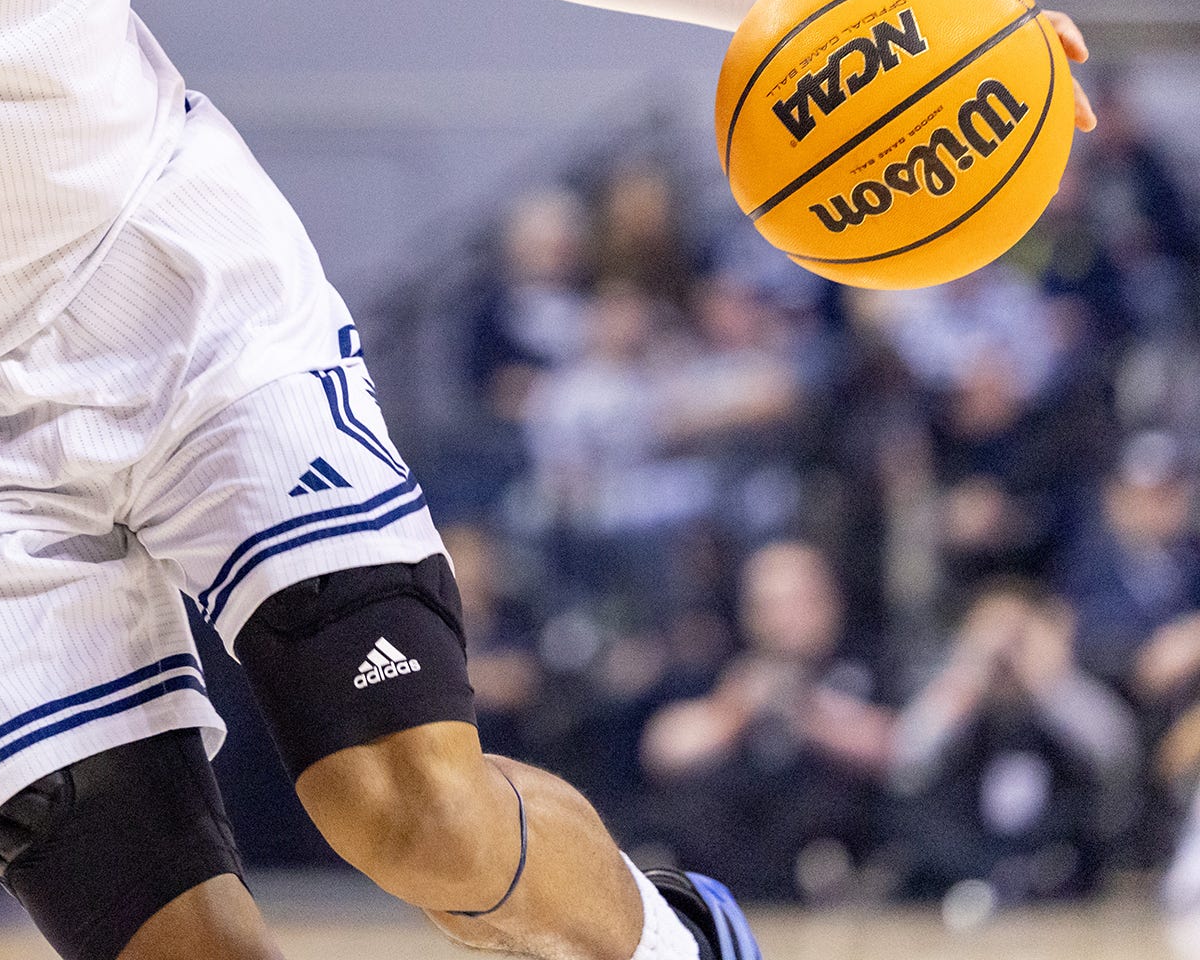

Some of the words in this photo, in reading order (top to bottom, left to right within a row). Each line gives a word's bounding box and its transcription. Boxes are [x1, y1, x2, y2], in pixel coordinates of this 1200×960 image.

[799, 35, 840, 69] GAME
[765, 68, 798, 98] BALL
[771, 7, 928, 143] NCAA
[908, 105, 943, 136] INDOOR
[809, 78, 1030, 234] Wilson
[878, 136, 906, 159] GAME
[850, 159, 876, 174] BALL
[353, 658, 422, 690] adidas
